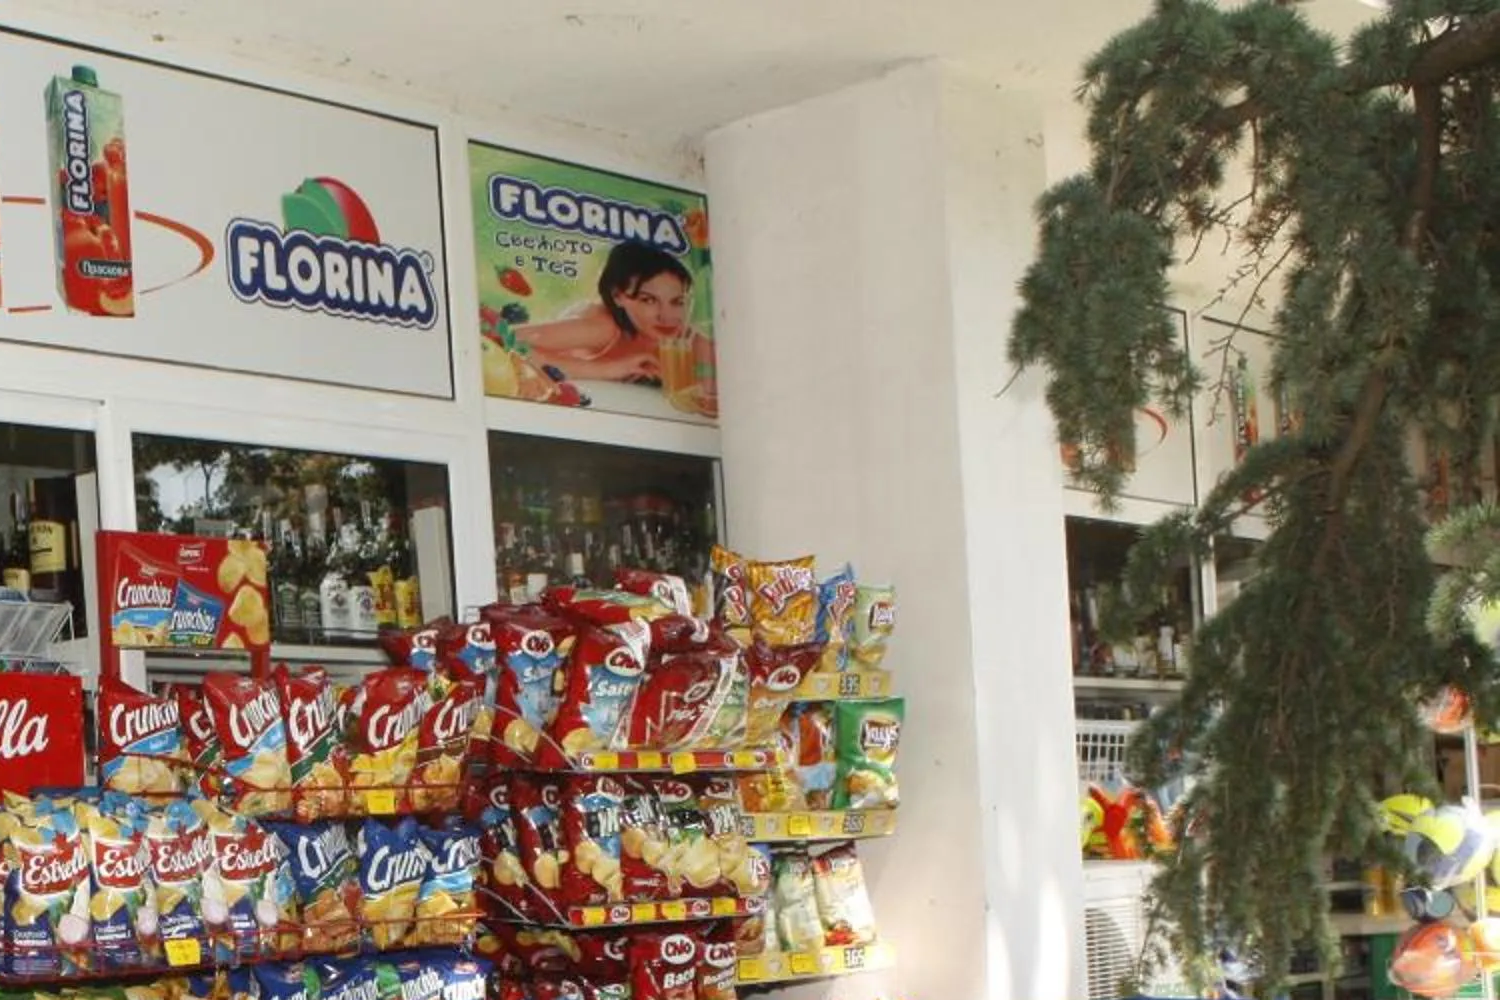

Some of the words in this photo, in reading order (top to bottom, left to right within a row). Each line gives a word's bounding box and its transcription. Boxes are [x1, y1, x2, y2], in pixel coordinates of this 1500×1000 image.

[64, 91, 91, 214] FLORINA
[494, 180, 685, 248] FLORINA
[235, 232, 433, 319] FLORINA
[117, 577, 173, 609] Crunchips
[170, 608, 216, 633] runchips
[25, 847, 88, 886] Estrell
[100, 847, 151, 876] Estr
[663, 940, 693, 958] Chio
[664, 968, 696, 988] Baco
